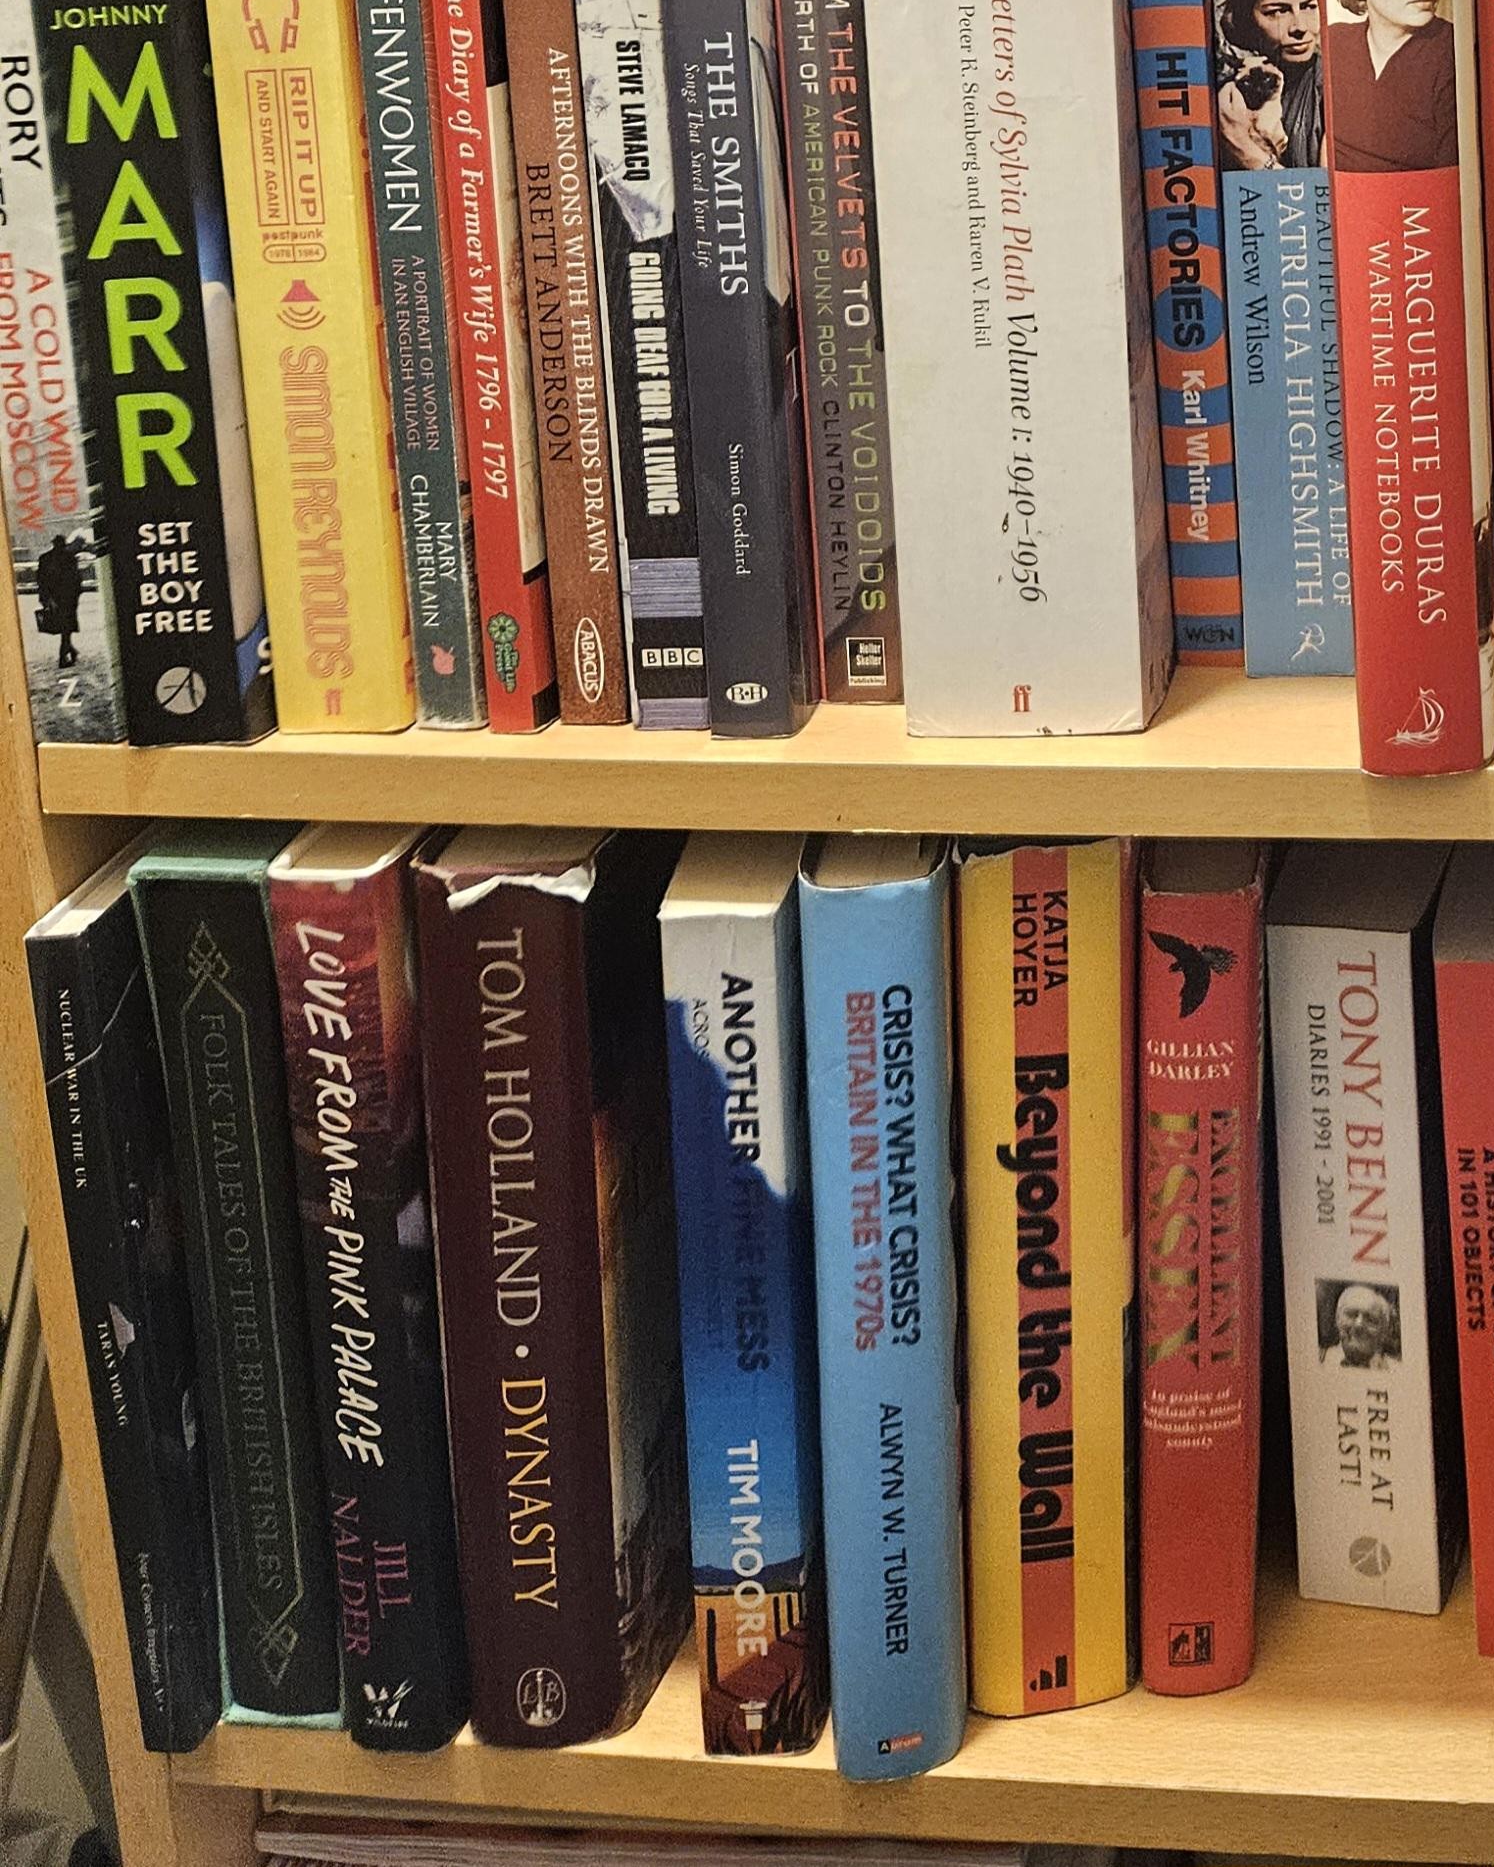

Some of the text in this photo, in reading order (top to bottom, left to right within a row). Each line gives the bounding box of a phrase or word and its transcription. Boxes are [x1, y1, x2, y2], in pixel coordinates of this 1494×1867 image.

[49, 3, 169, 30] JOHNNY
[256, 79, 281, 220] AND START AGAIN
[290, 75, 317, 218] RIP IT UP
[703, 32, 749, 297] THE SMITHS
[988, 89, 1028, 126] of
[990, 124, 1031, 218] Sylvia
[66, 41, 199, 491] MARR
[1001, 224, 1033, 303] Plath
[1402, 205, 1447, 625] MARGUERITE DURAS
[137, 551, 199, 576] THE
[139, 521, 194, 546] SET
[139, 580, 203, 605] BOY
[136, 609, 214, 635] FREE
[1012, 893, 1037, 1009] HOYER
[1041, 890, 1069, 992] KATJA
[882, 983, 921, 1346] CRISIS? WHAT CRISIS?
[1336, 950, 1391, 1269] TONY BENN
[477, 928, 559, 1611] TOM HOLLAND DYNASTY
[995, 1054, 1074, 1563] Beyond the Wall
[726, 1439, 767, 1657] TIM MOORE
[879, 1402, 909, 1657] ALWYN W. TURNER
